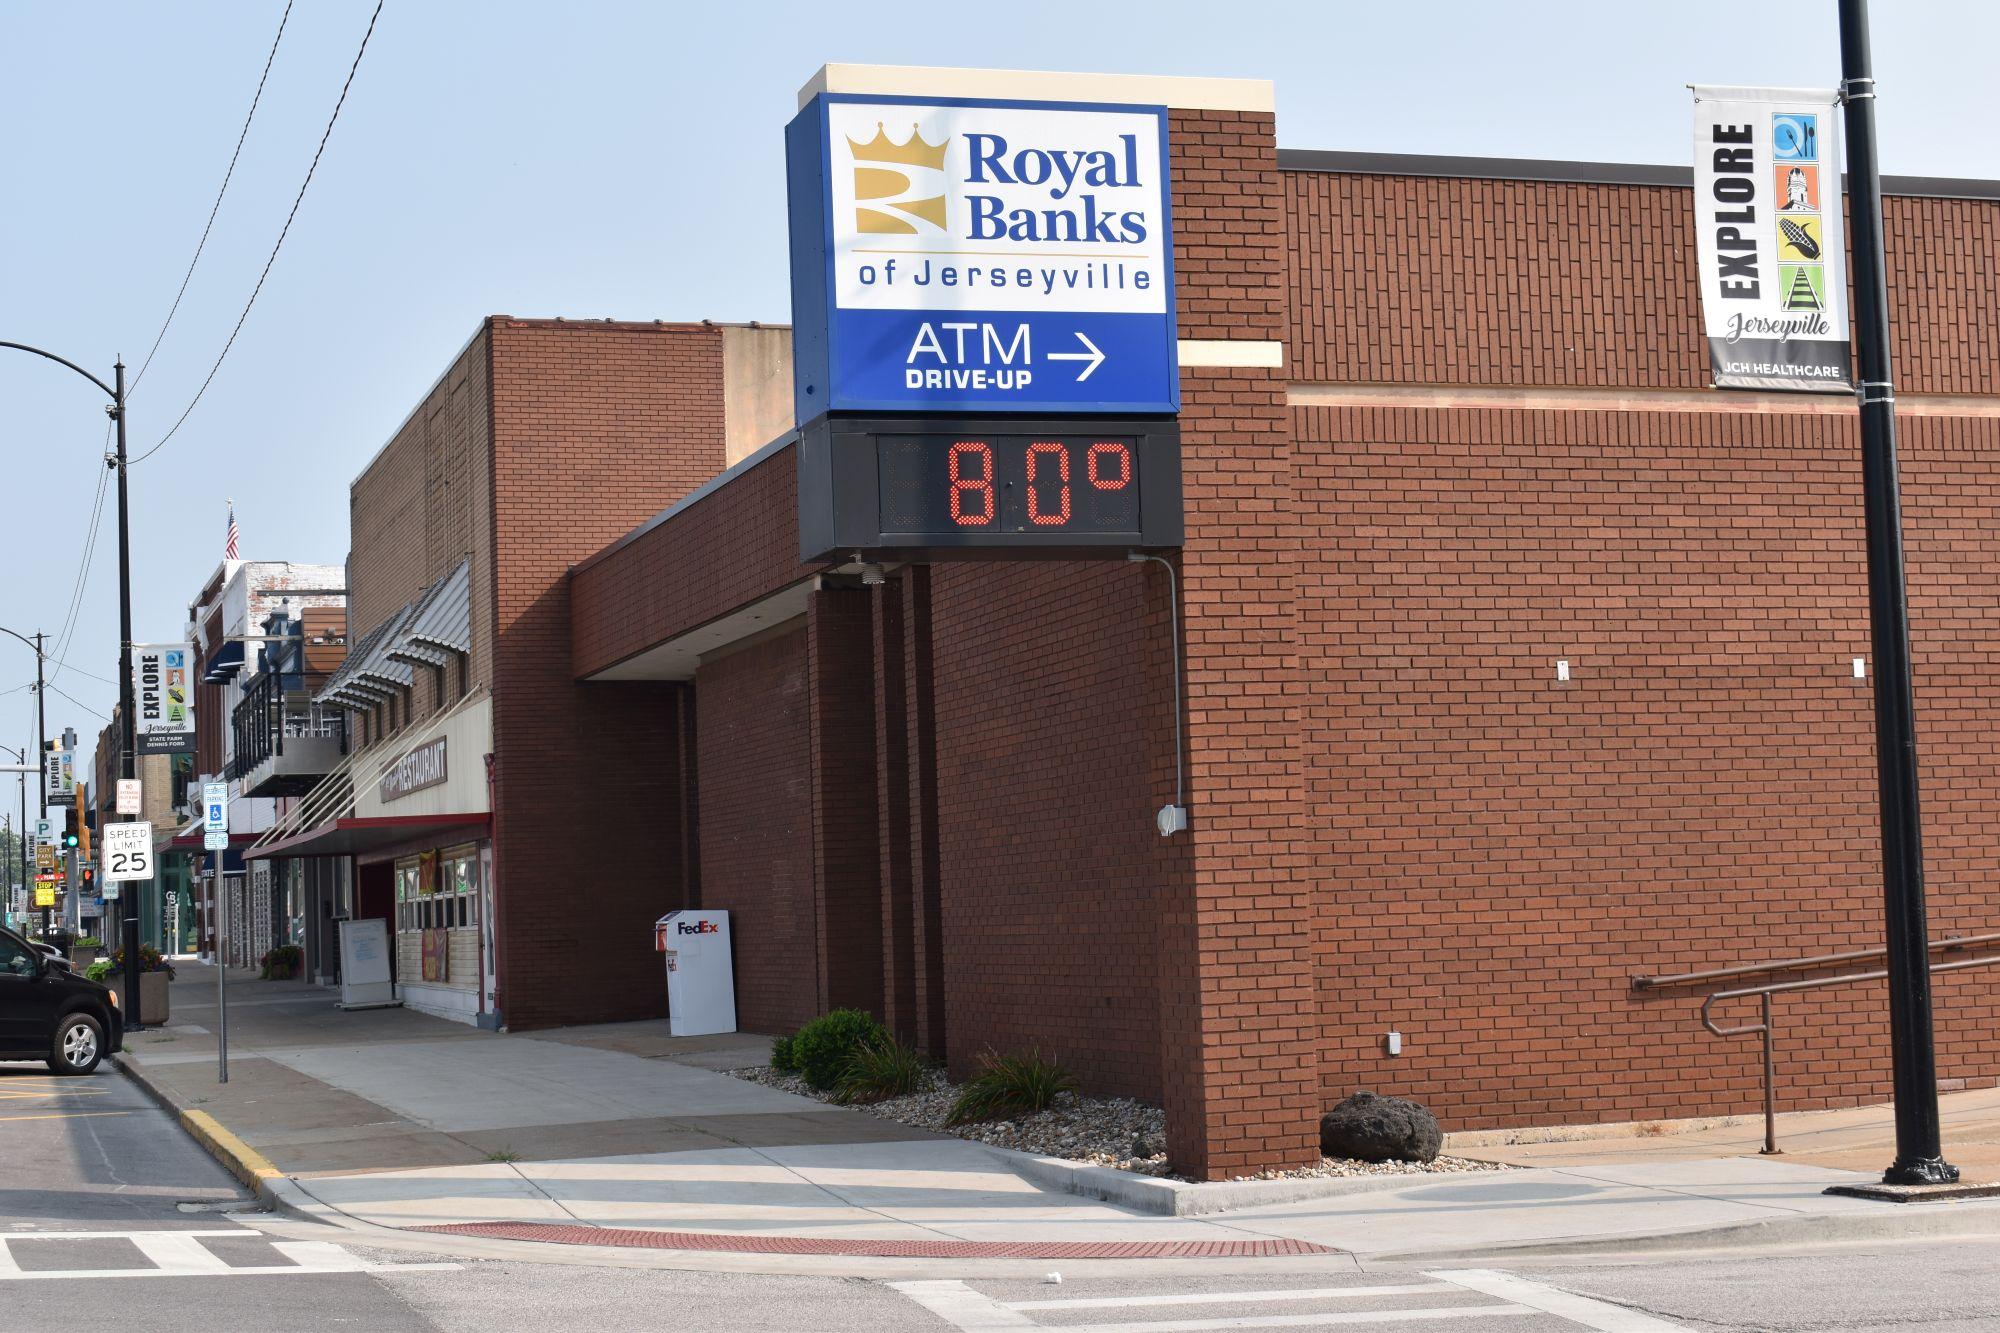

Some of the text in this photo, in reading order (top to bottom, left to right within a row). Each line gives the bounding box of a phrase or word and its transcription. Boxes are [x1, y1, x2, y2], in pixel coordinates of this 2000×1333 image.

[962, 133, 1143, 200] Royal
[964, 194, 1147, 244] Banks
[1712, 124, 1760, 299] EXPLORE
[858, 259, 1151, 295] of Jerseyville
[1726, 312, 1830, 343] Jerseyville
[906, 322, 1031, 365] ATM
[905, 368, 1032, 390] DRIVE-UP
[1724, 361, 1840, 378] JCH HEALTHCARE
[142, 655, 160, 719] EXPLORE
[145, 722, 187, 735] Jerseyville
[51, 756, 60, 789] EXPLORE
[399, 741, 445, 792] RESTAURANT
[38, 823, 50, 835] P
[109, 829, 147, 839] SPEED
[113, 840, 143, 851] LIMIT
[111, 852, 146, 873] 25
[677, 920, 718, 935] FedEx
